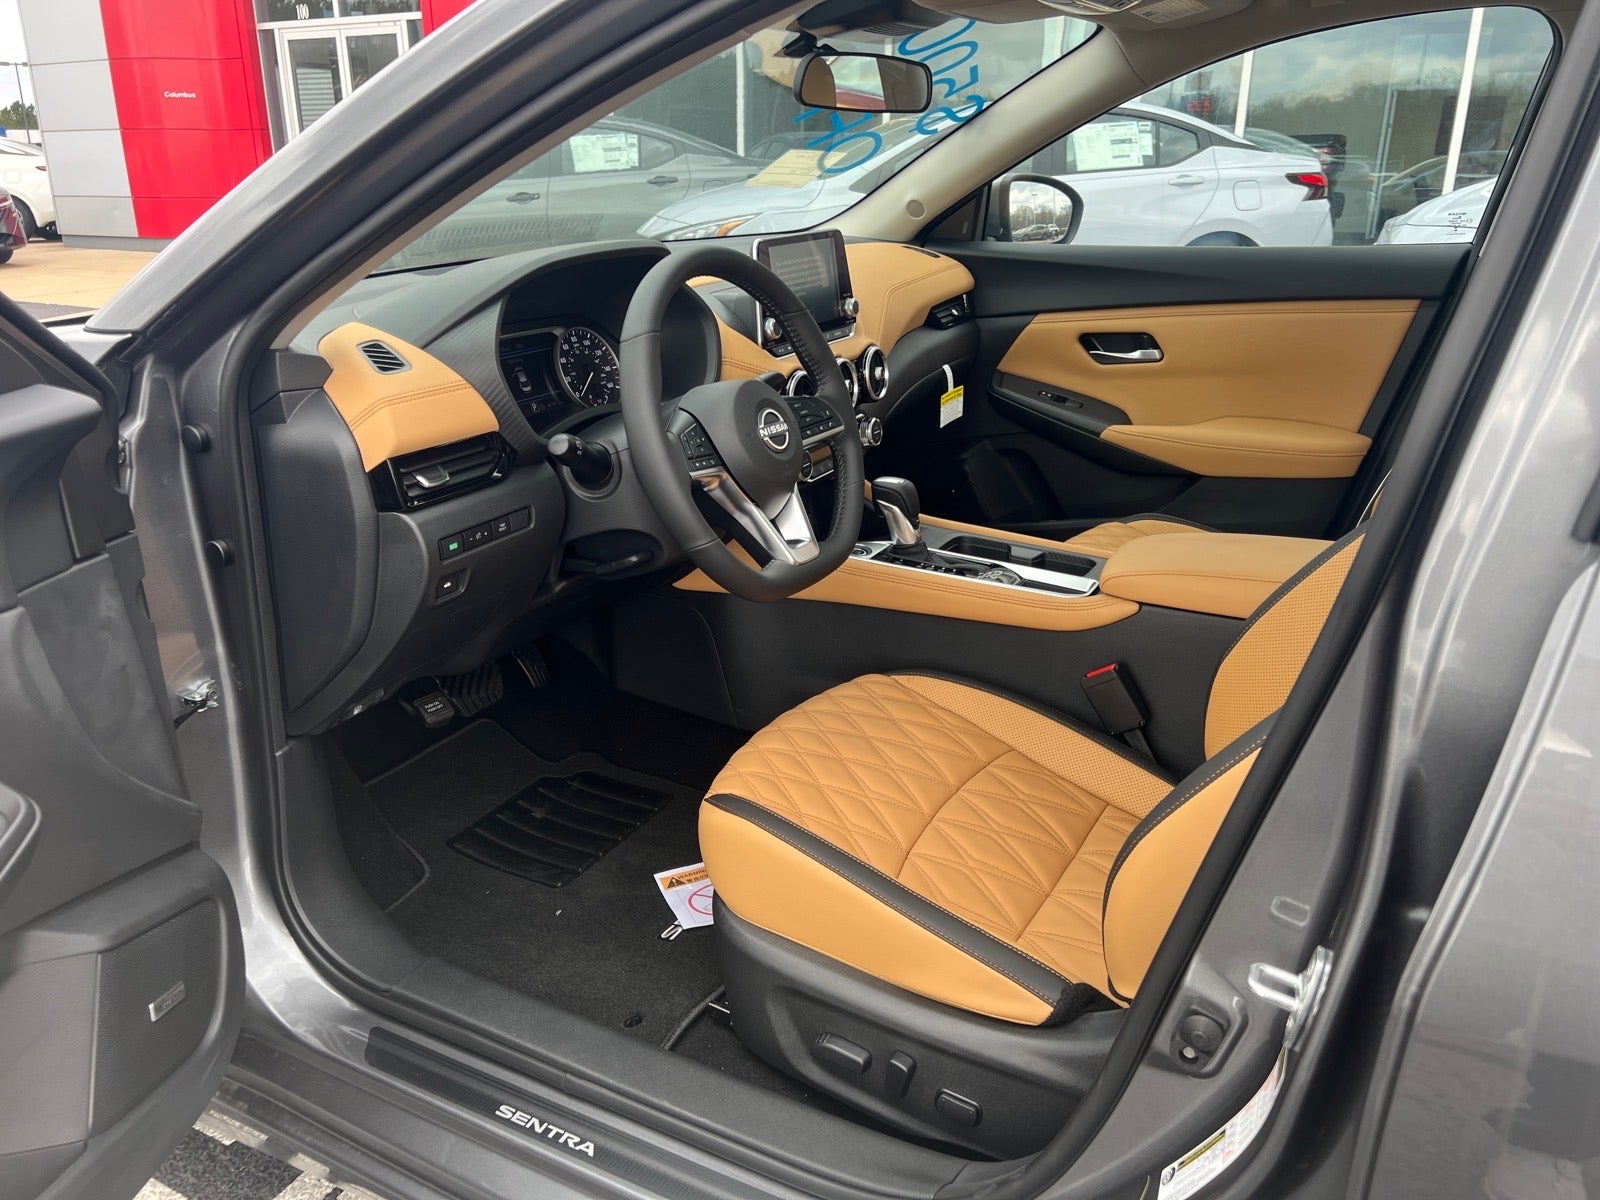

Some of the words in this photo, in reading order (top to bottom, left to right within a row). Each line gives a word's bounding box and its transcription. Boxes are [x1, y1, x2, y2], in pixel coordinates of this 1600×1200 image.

[295, 3, 310, 20] 100
[163, 90, 197, 99] Columbus
[759, 422, 789, 437] NISSAN
[495, 1104, 594, 1157] SENTRA
